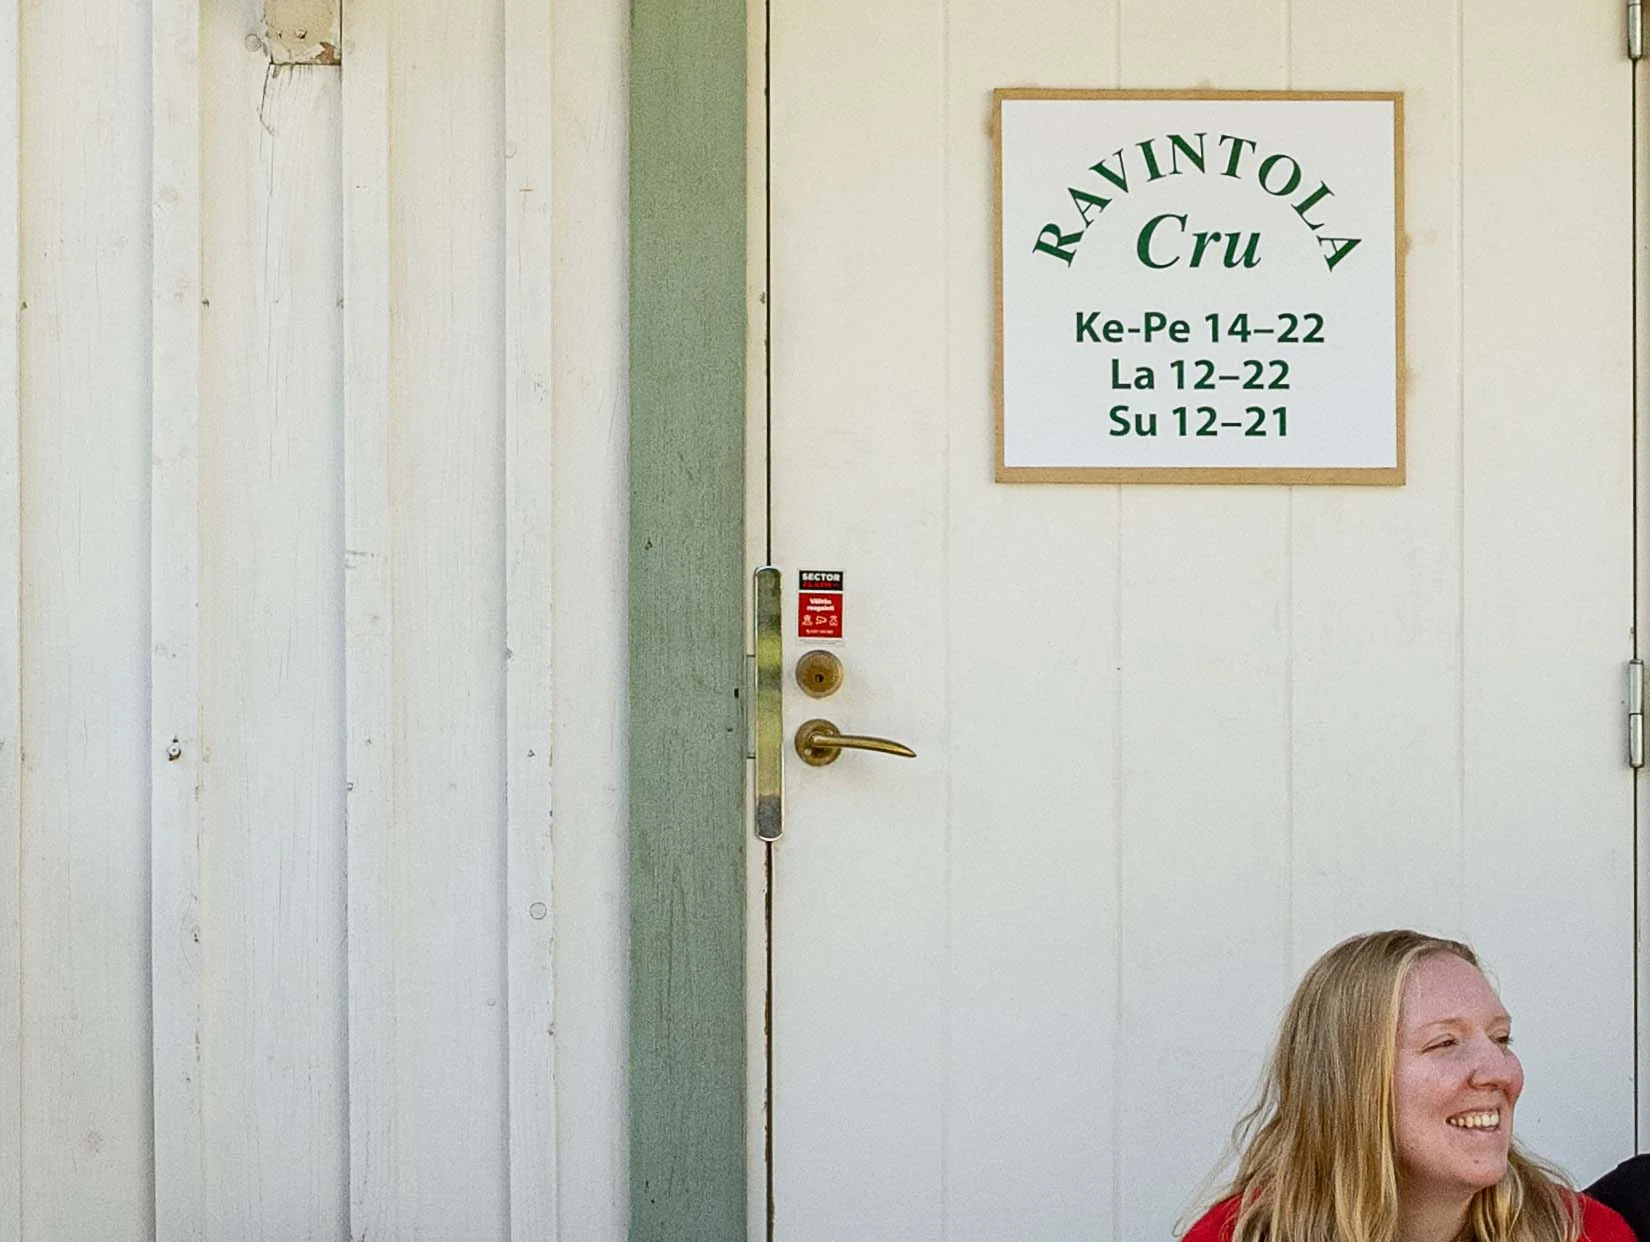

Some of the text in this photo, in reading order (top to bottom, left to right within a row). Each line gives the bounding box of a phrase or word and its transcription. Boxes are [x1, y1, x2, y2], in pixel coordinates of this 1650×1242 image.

[1032, 132, 1362, 272] RAVINTOLA
[1136, 213, 1262, 269] Cru
[1075, 311, 1325, 344] Ke-Pe 14–22
[1111, 358, 1290, 390] La 12–22
[1109, 405, 1287, 437] Su 12–21
[802, 573, 841, 582] SECTOR
